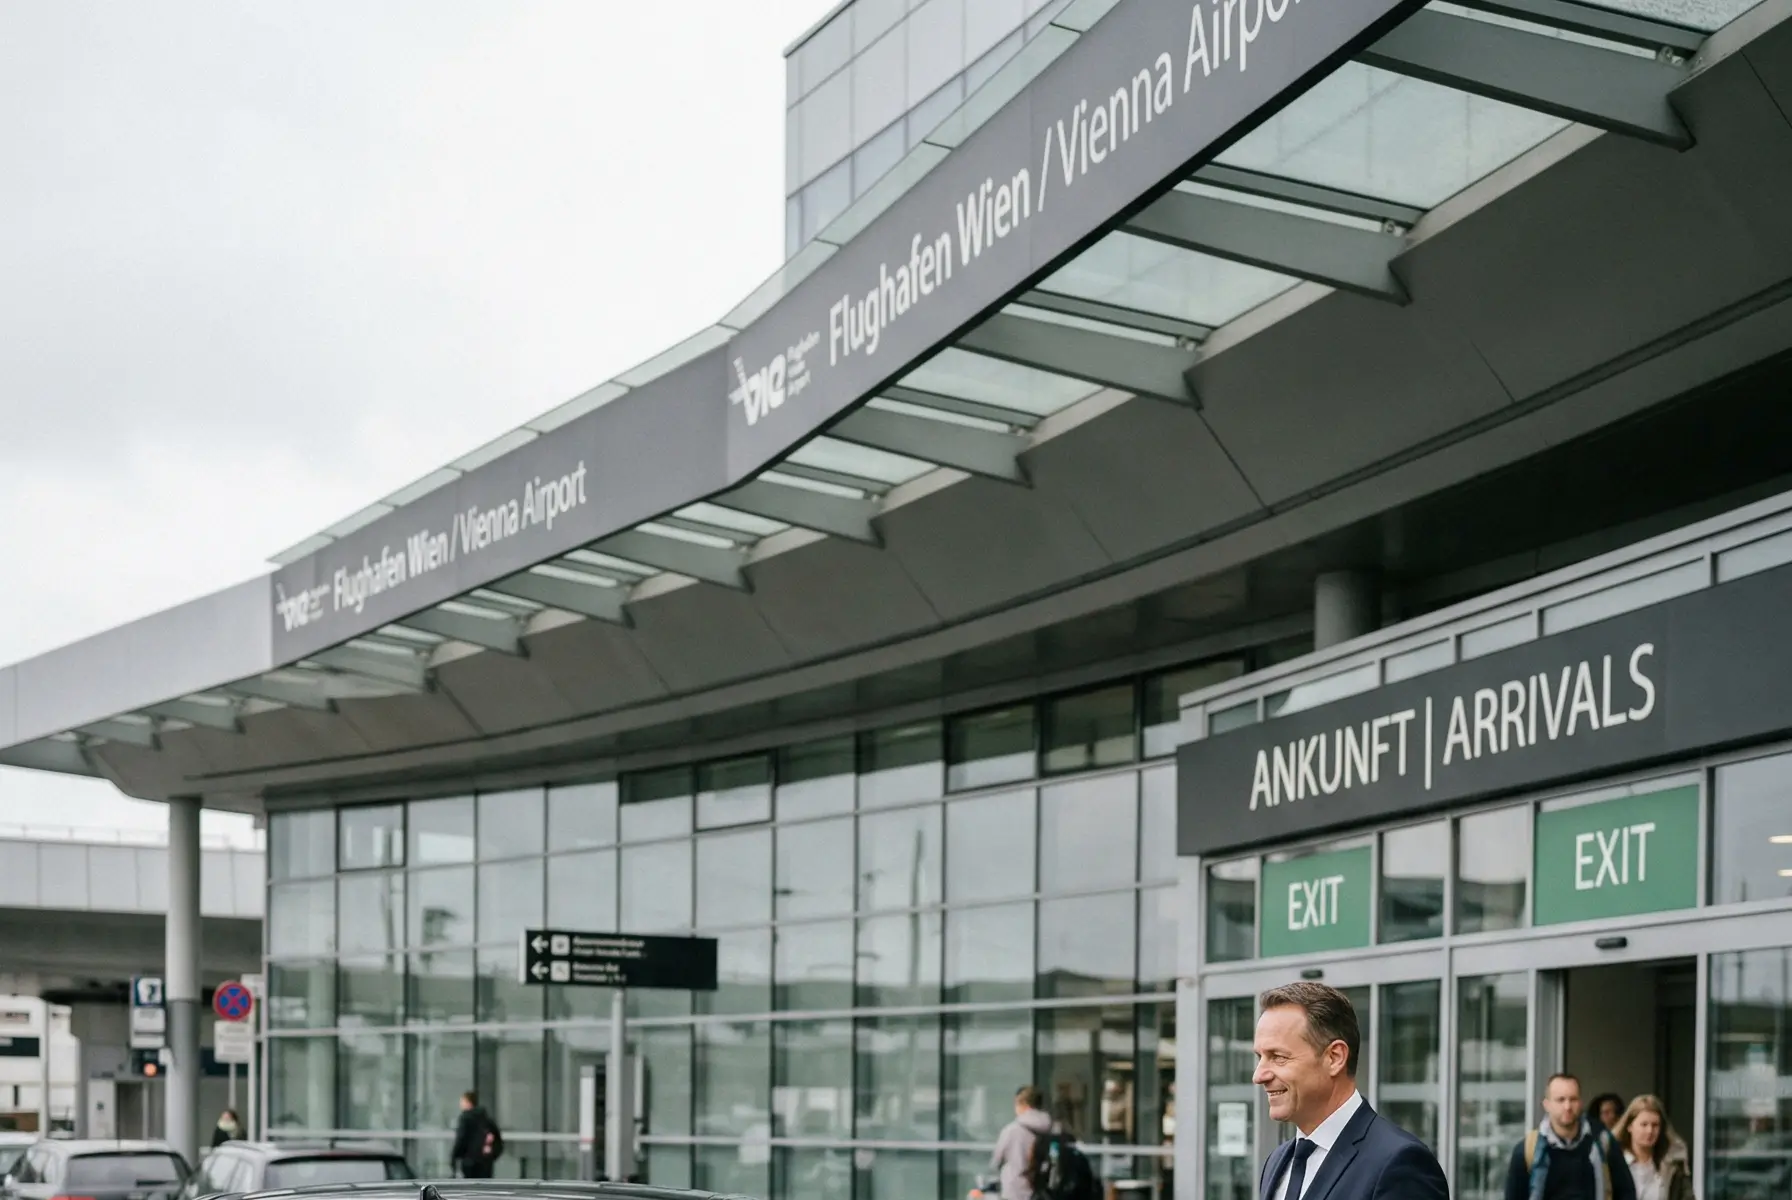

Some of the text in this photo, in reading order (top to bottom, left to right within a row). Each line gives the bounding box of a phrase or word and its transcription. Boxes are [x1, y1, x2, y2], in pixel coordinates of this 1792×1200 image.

[830, 232, 951, 367] Flughafen
[956, 168, 1030, 266] Wien
[1056, 51, 1173, 187] Vienna
[1183, 0, 1301, 94] Airp
[333, 545, 406, 614] Flughafen
[407, 529, 448, 578] Wien
[460, 499, 517, 554] Vienna
[521, 460, 587, 530] Airport
[1249, 709, 1415, 811] ANKUNFT
[1442, 643, 1656, 765] ARRIVALS
[1288, 875, 1344, 931] EXIT
[1575, 822, 1656, 891] EXIT
